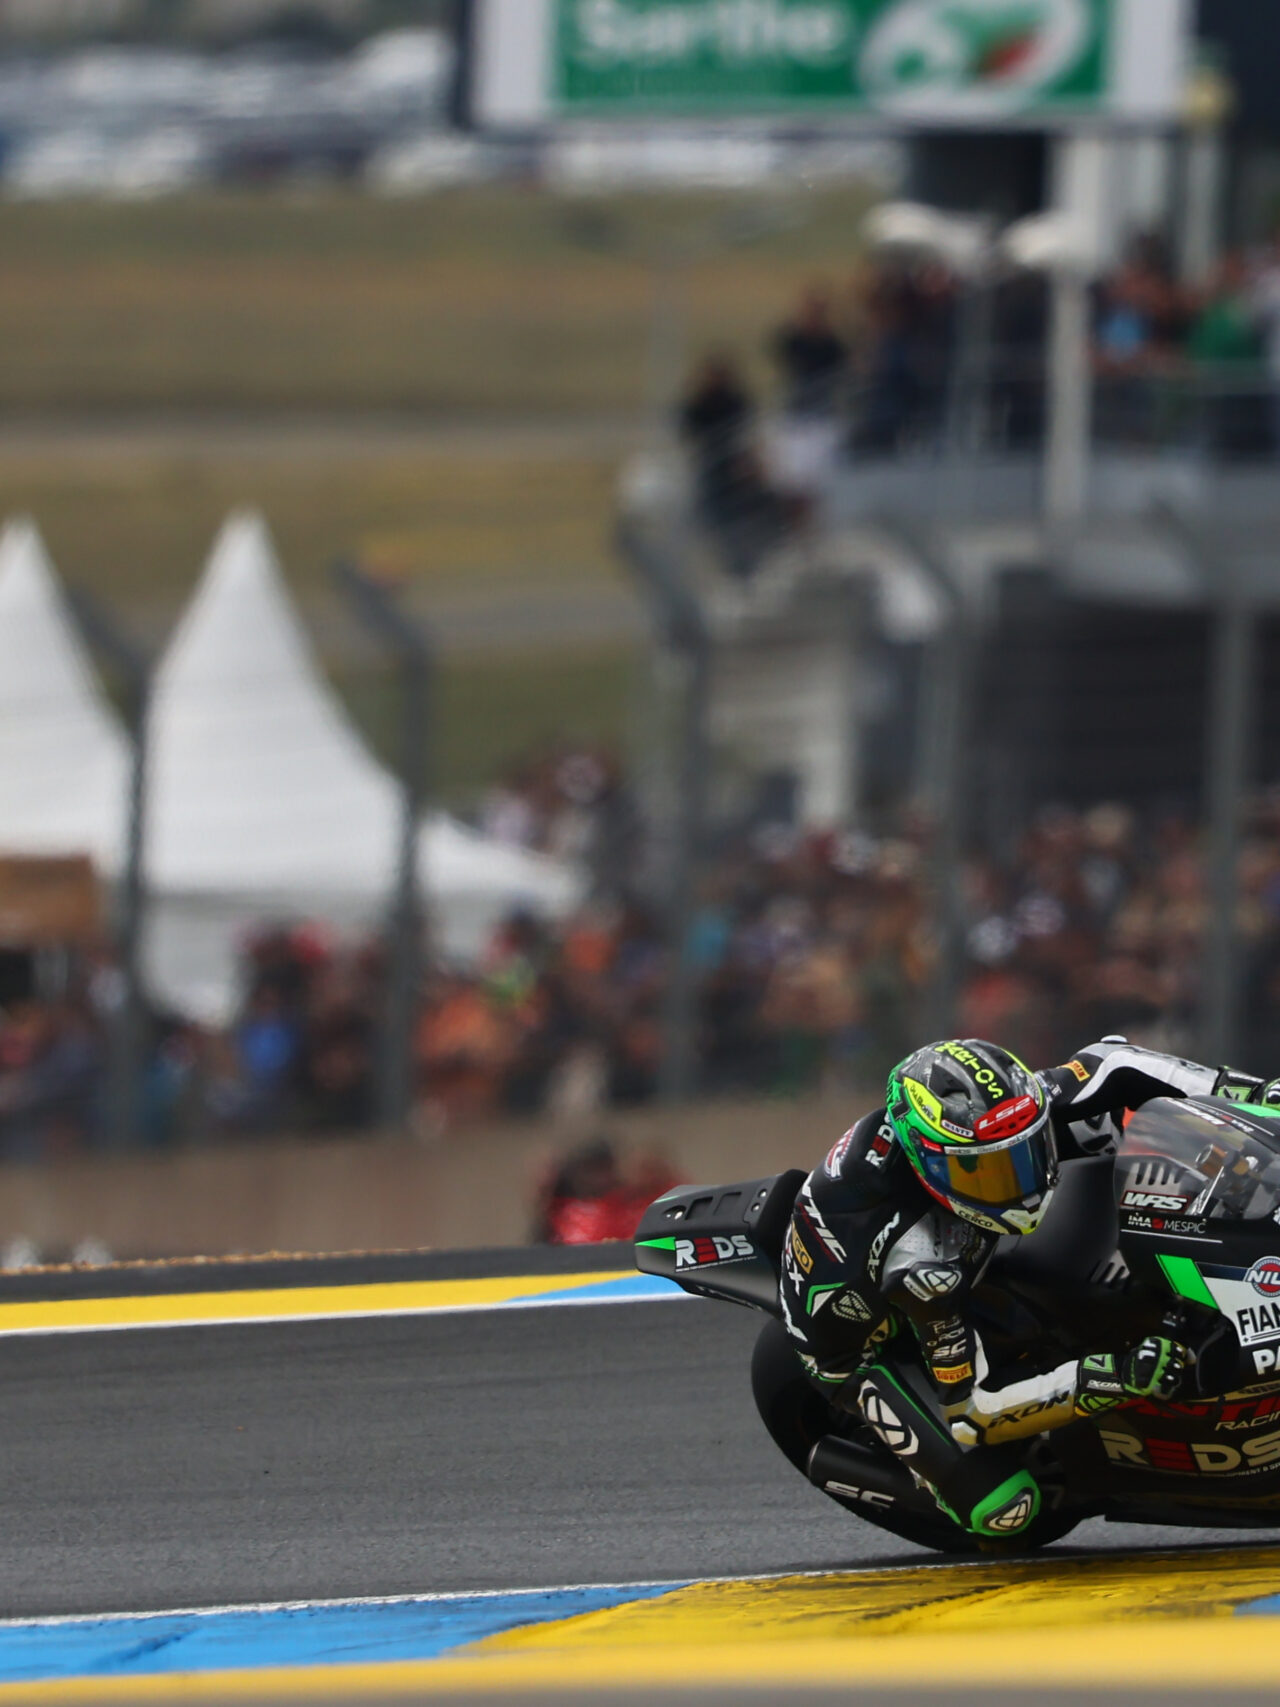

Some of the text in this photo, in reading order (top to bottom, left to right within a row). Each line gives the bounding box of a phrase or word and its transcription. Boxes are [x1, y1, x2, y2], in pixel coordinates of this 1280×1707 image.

[978, 1097, 1031, 1130] LS2
[944, 1122, 971, 1136] WANTY
[1123, 1192, 1188, 1211] WRS
[958, 1210, 993, 1228] CERCO
[1163, 1219, 1207, 1235] MESPIC
[675, 1234, 754, 1268] REDS
[824, 1480, 896, 1509] SC
